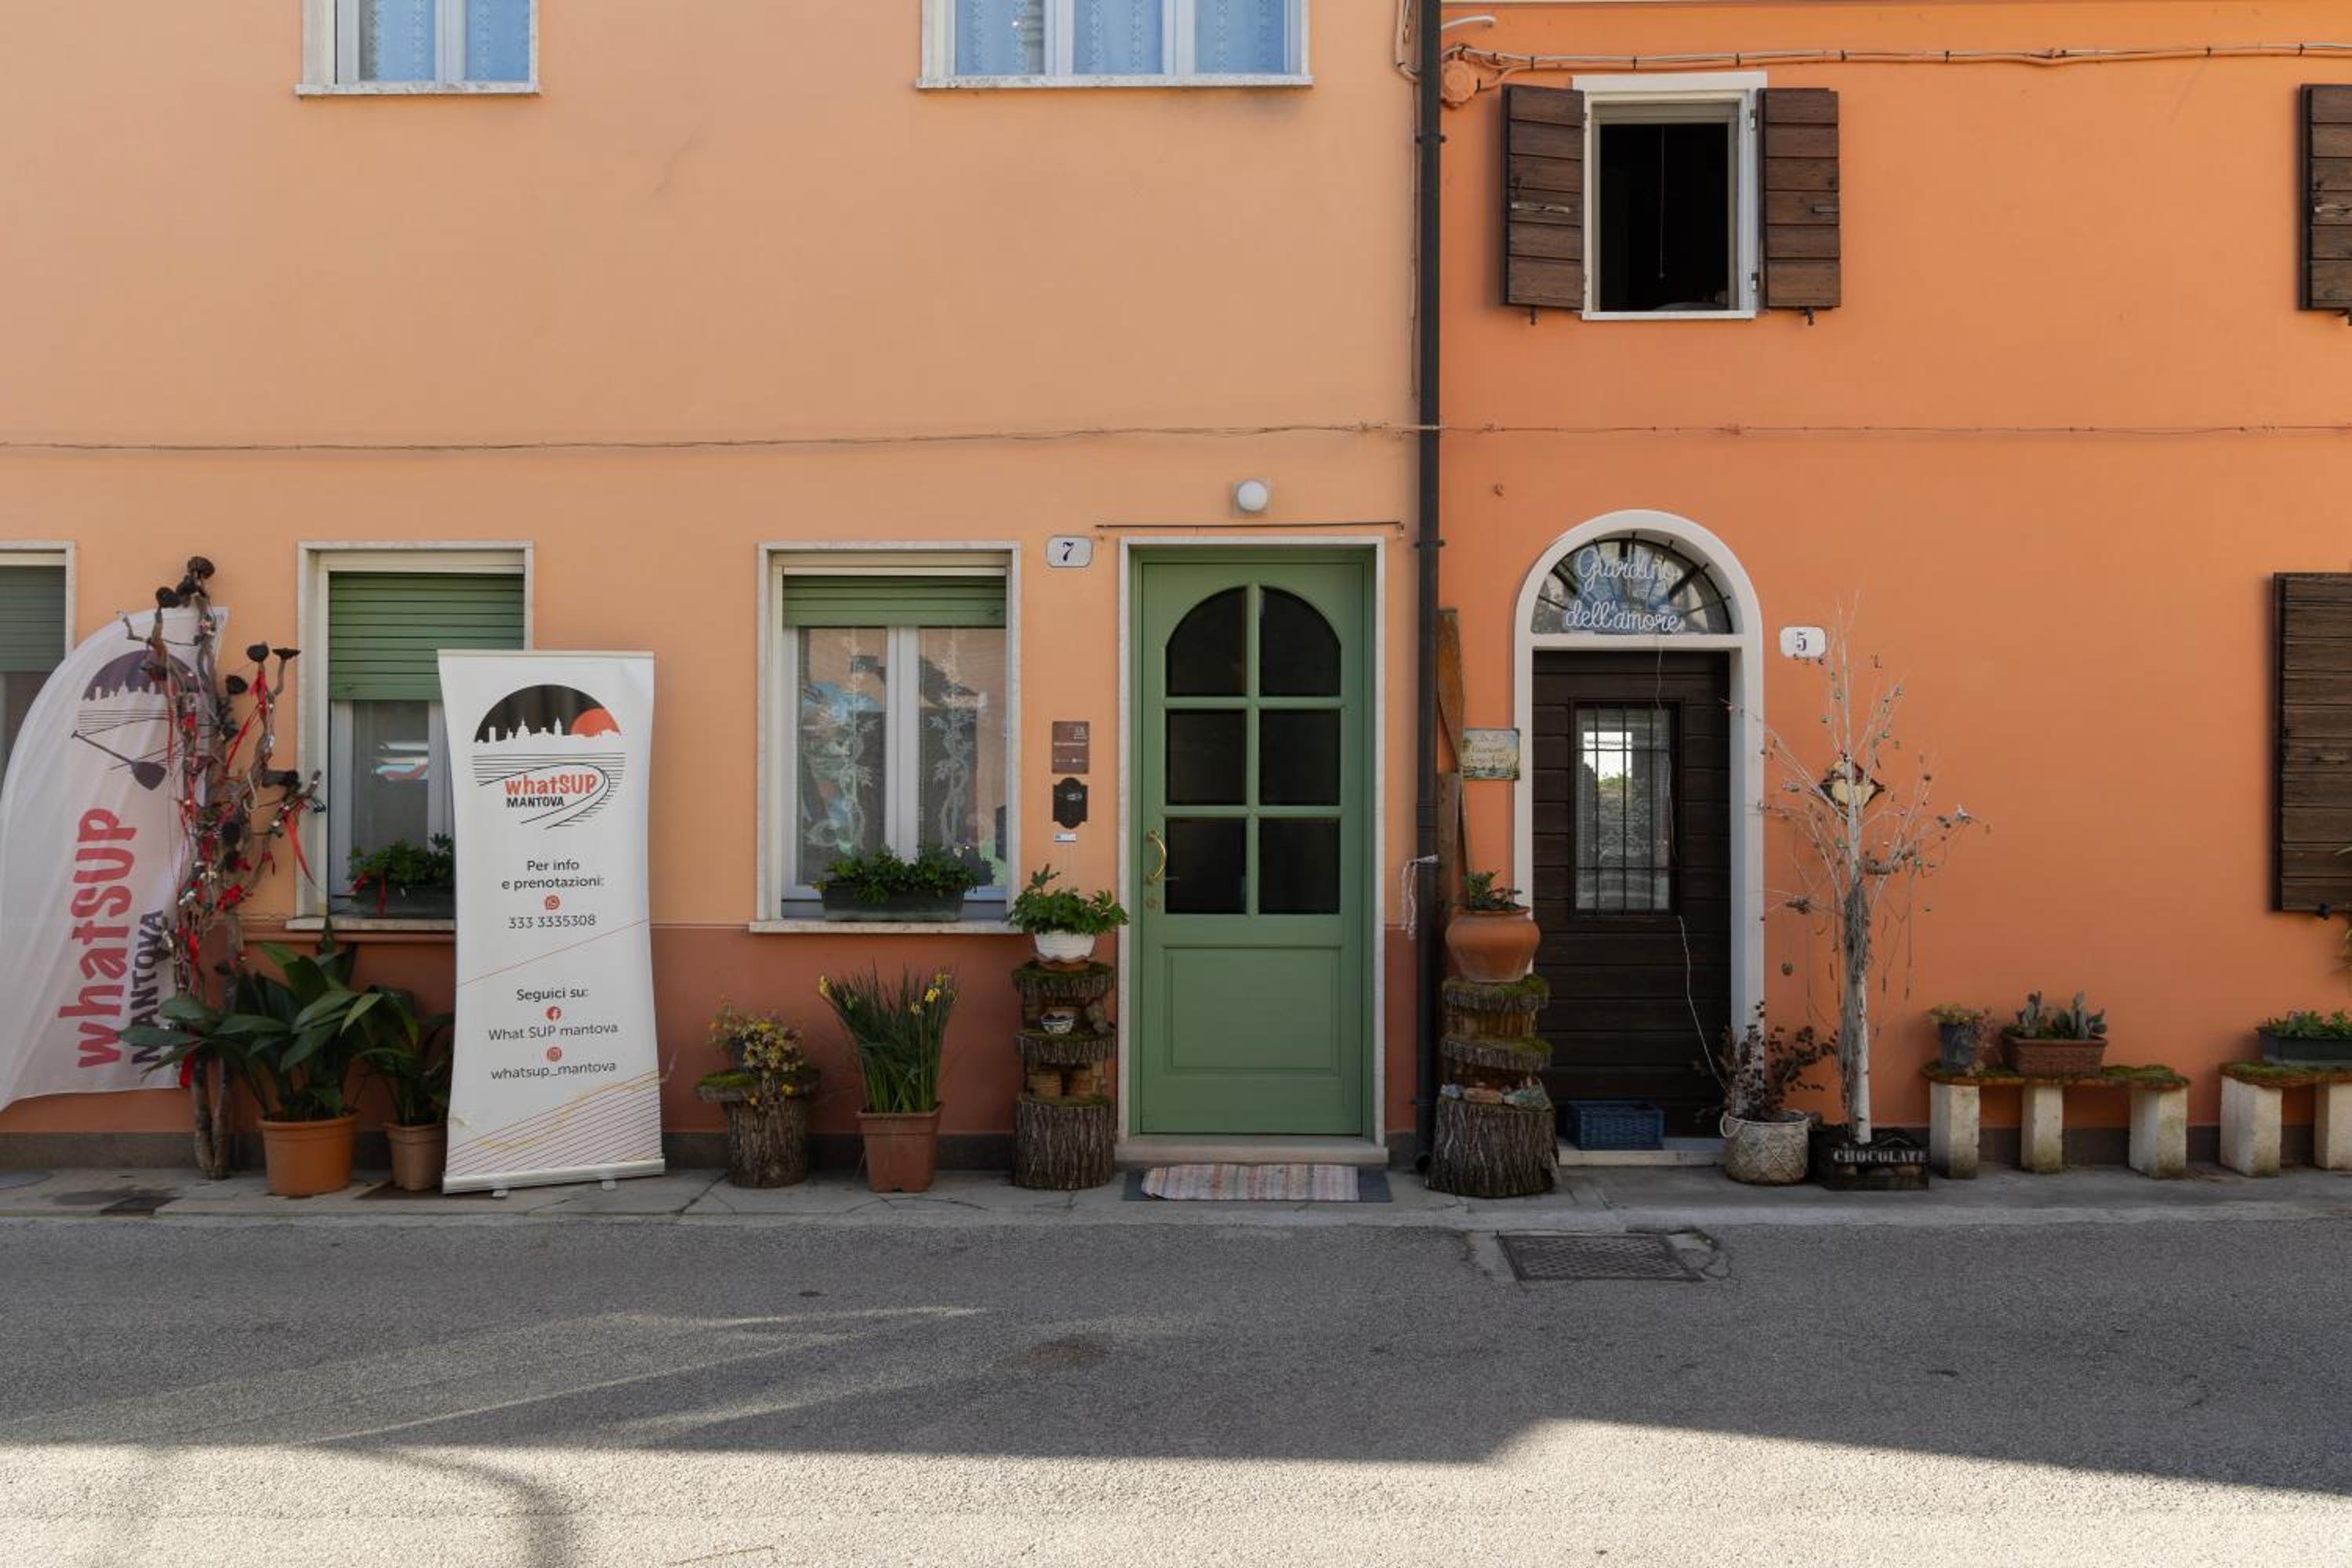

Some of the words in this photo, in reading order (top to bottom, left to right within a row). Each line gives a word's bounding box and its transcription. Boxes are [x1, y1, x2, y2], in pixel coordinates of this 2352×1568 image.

[1063, 542, 1074, 561] 7
[1578, 548, 1679, 591] Giardino
[1566, 600, 1682, 633] dell'amore
[1796, 631, 1807, 652] 5
[504, 773, 597, 795] whatSUP
[506, 796, 564, 808] MANTOVA
[527, 860, 549, 871] Per
[553, 859, 580, 870] info
[502, 880, 510, 889] e
[514, 876, 604, 891] prenotazioni:
[508, 917, 533, 929] 333
[537, 914, 596, 927] 3335308
[517, 988, 565, 1002] Seguici
[570, 988, 588, 998] su:
[488, 1028, 524, 1040] What
[528, 1025, 556, 1038] SUP
[559, 1022, 618, 1036] mantova
[491, 1062, 616, 1080] whatsup_mantova
[1833, 1150, 1927, 1163] CHOCOLATE
